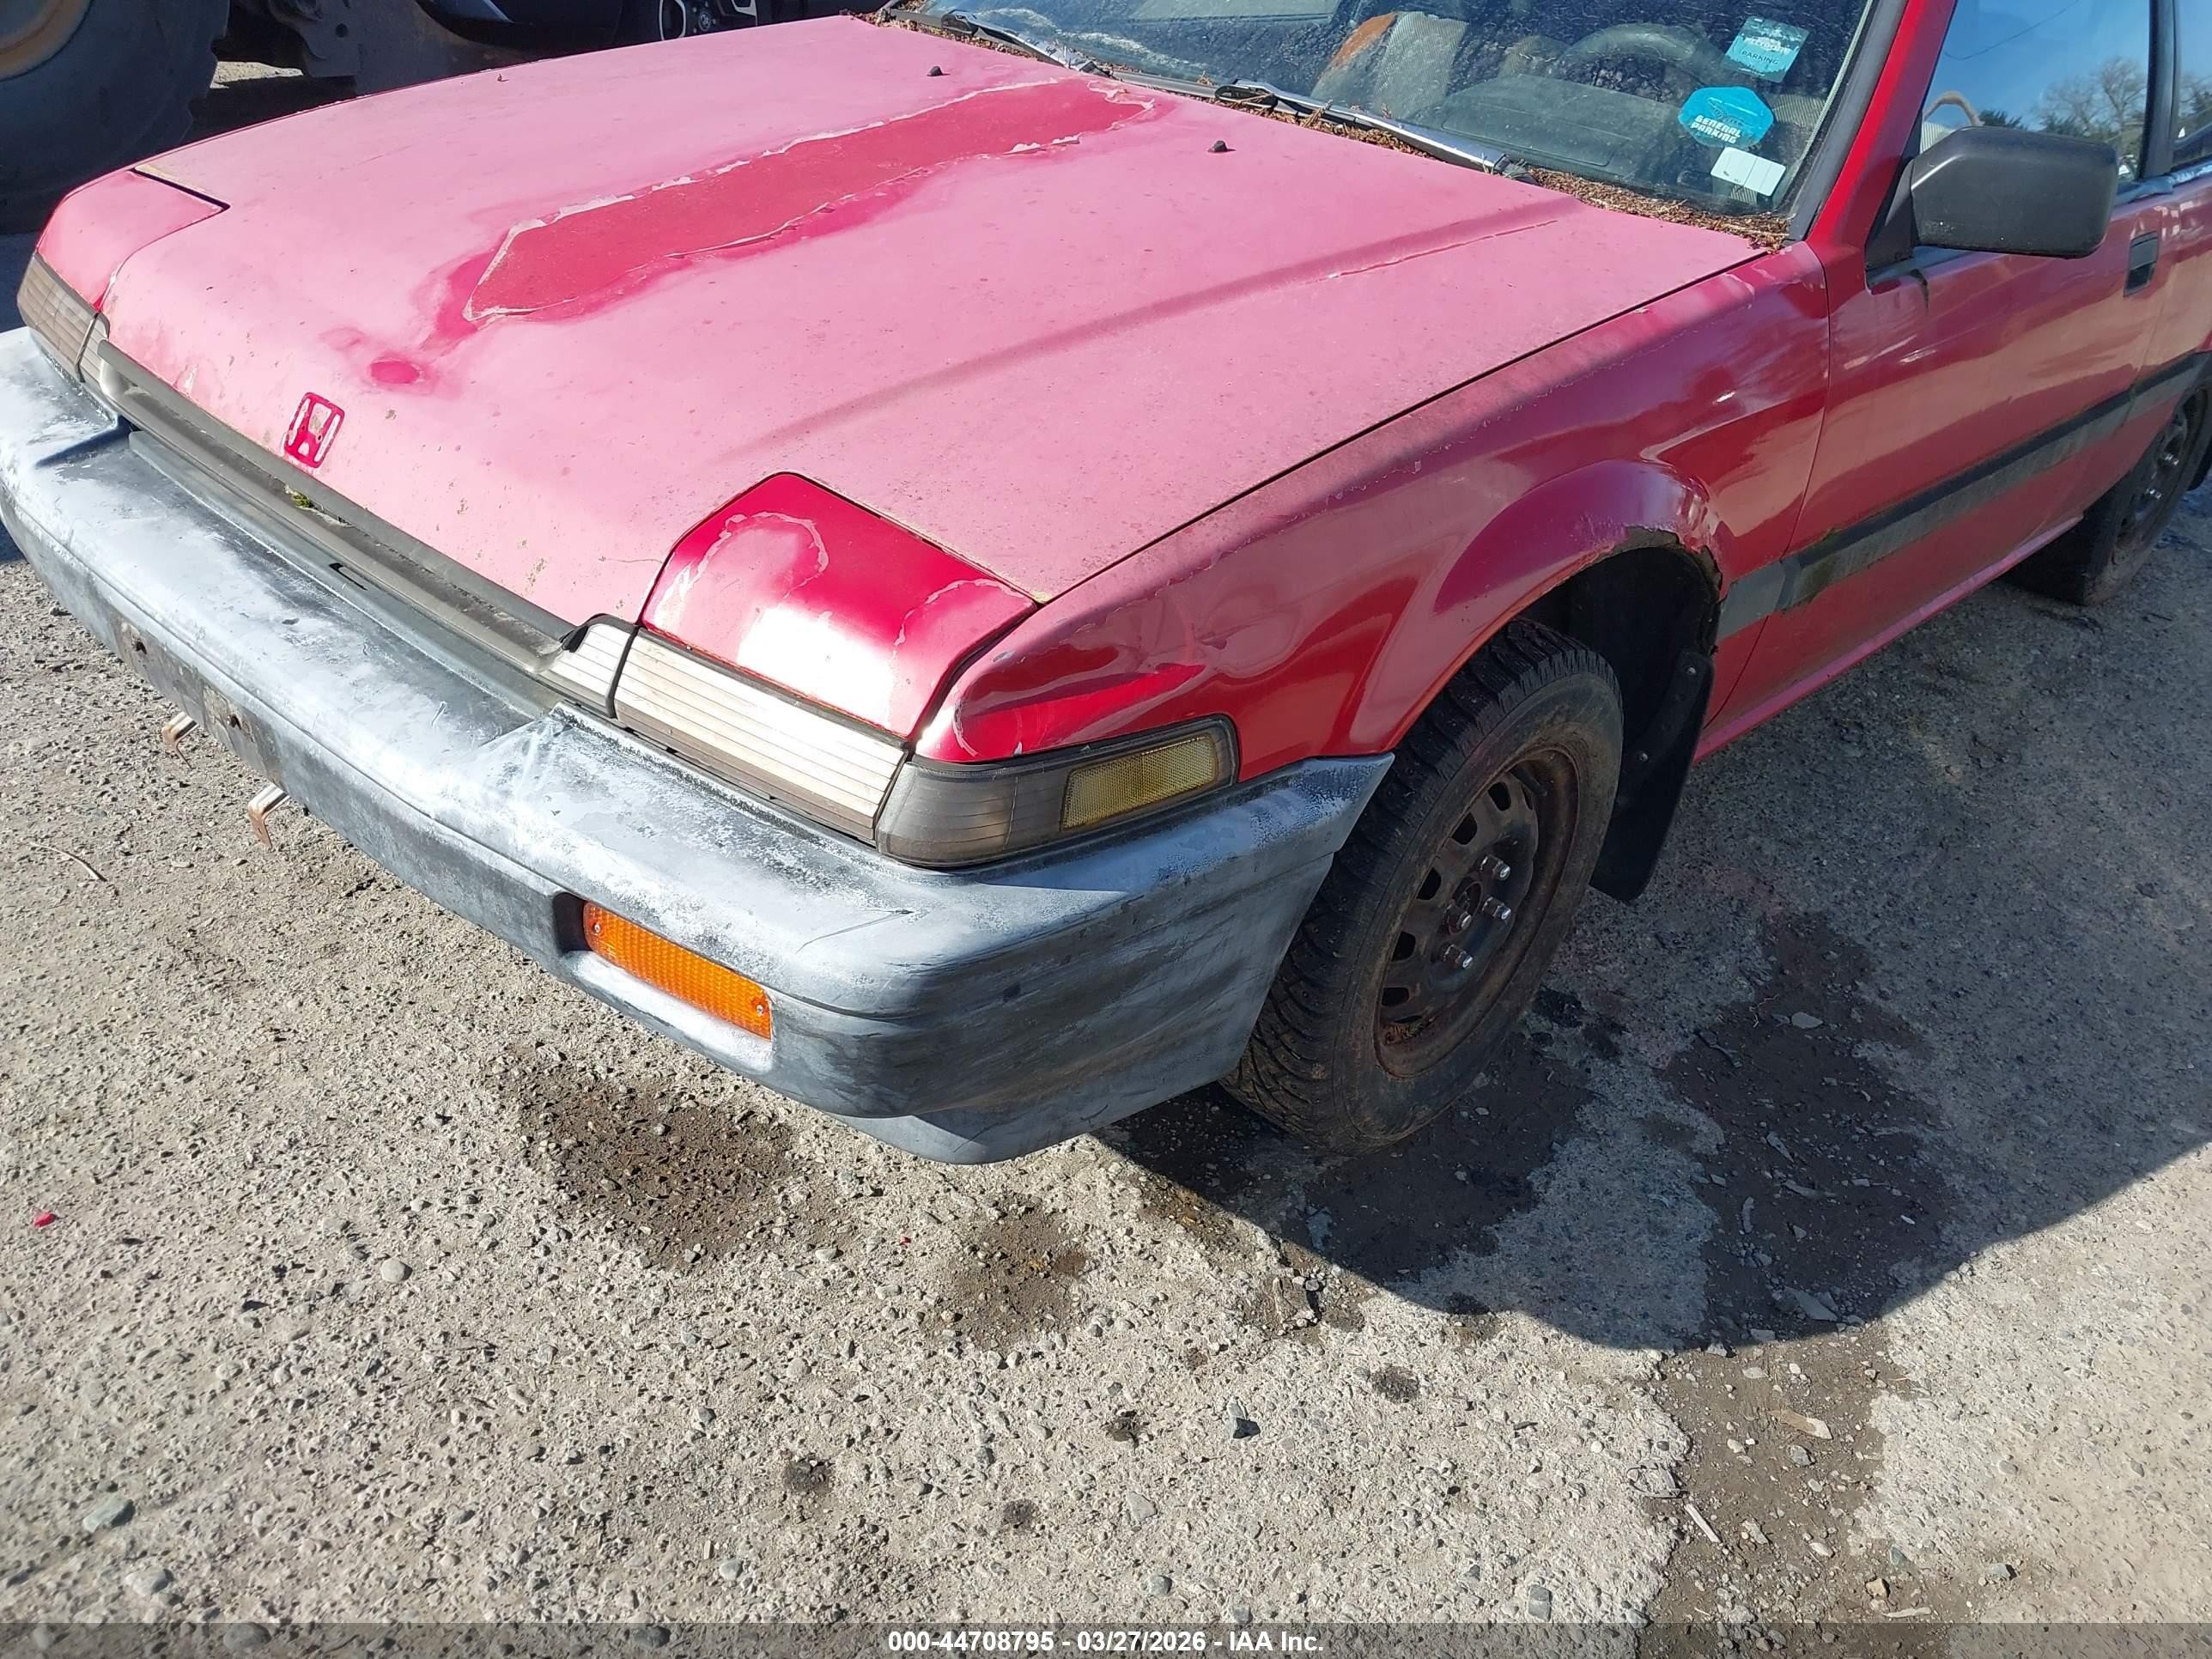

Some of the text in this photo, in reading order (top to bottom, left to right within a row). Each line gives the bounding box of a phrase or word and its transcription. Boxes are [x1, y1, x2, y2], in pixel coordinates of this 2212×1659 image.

[1741, 49, 1778, 64] PARKING
[1691, 122, 1737, 143] PARKING
[1695, 115, 1741, 137] GENERAL
